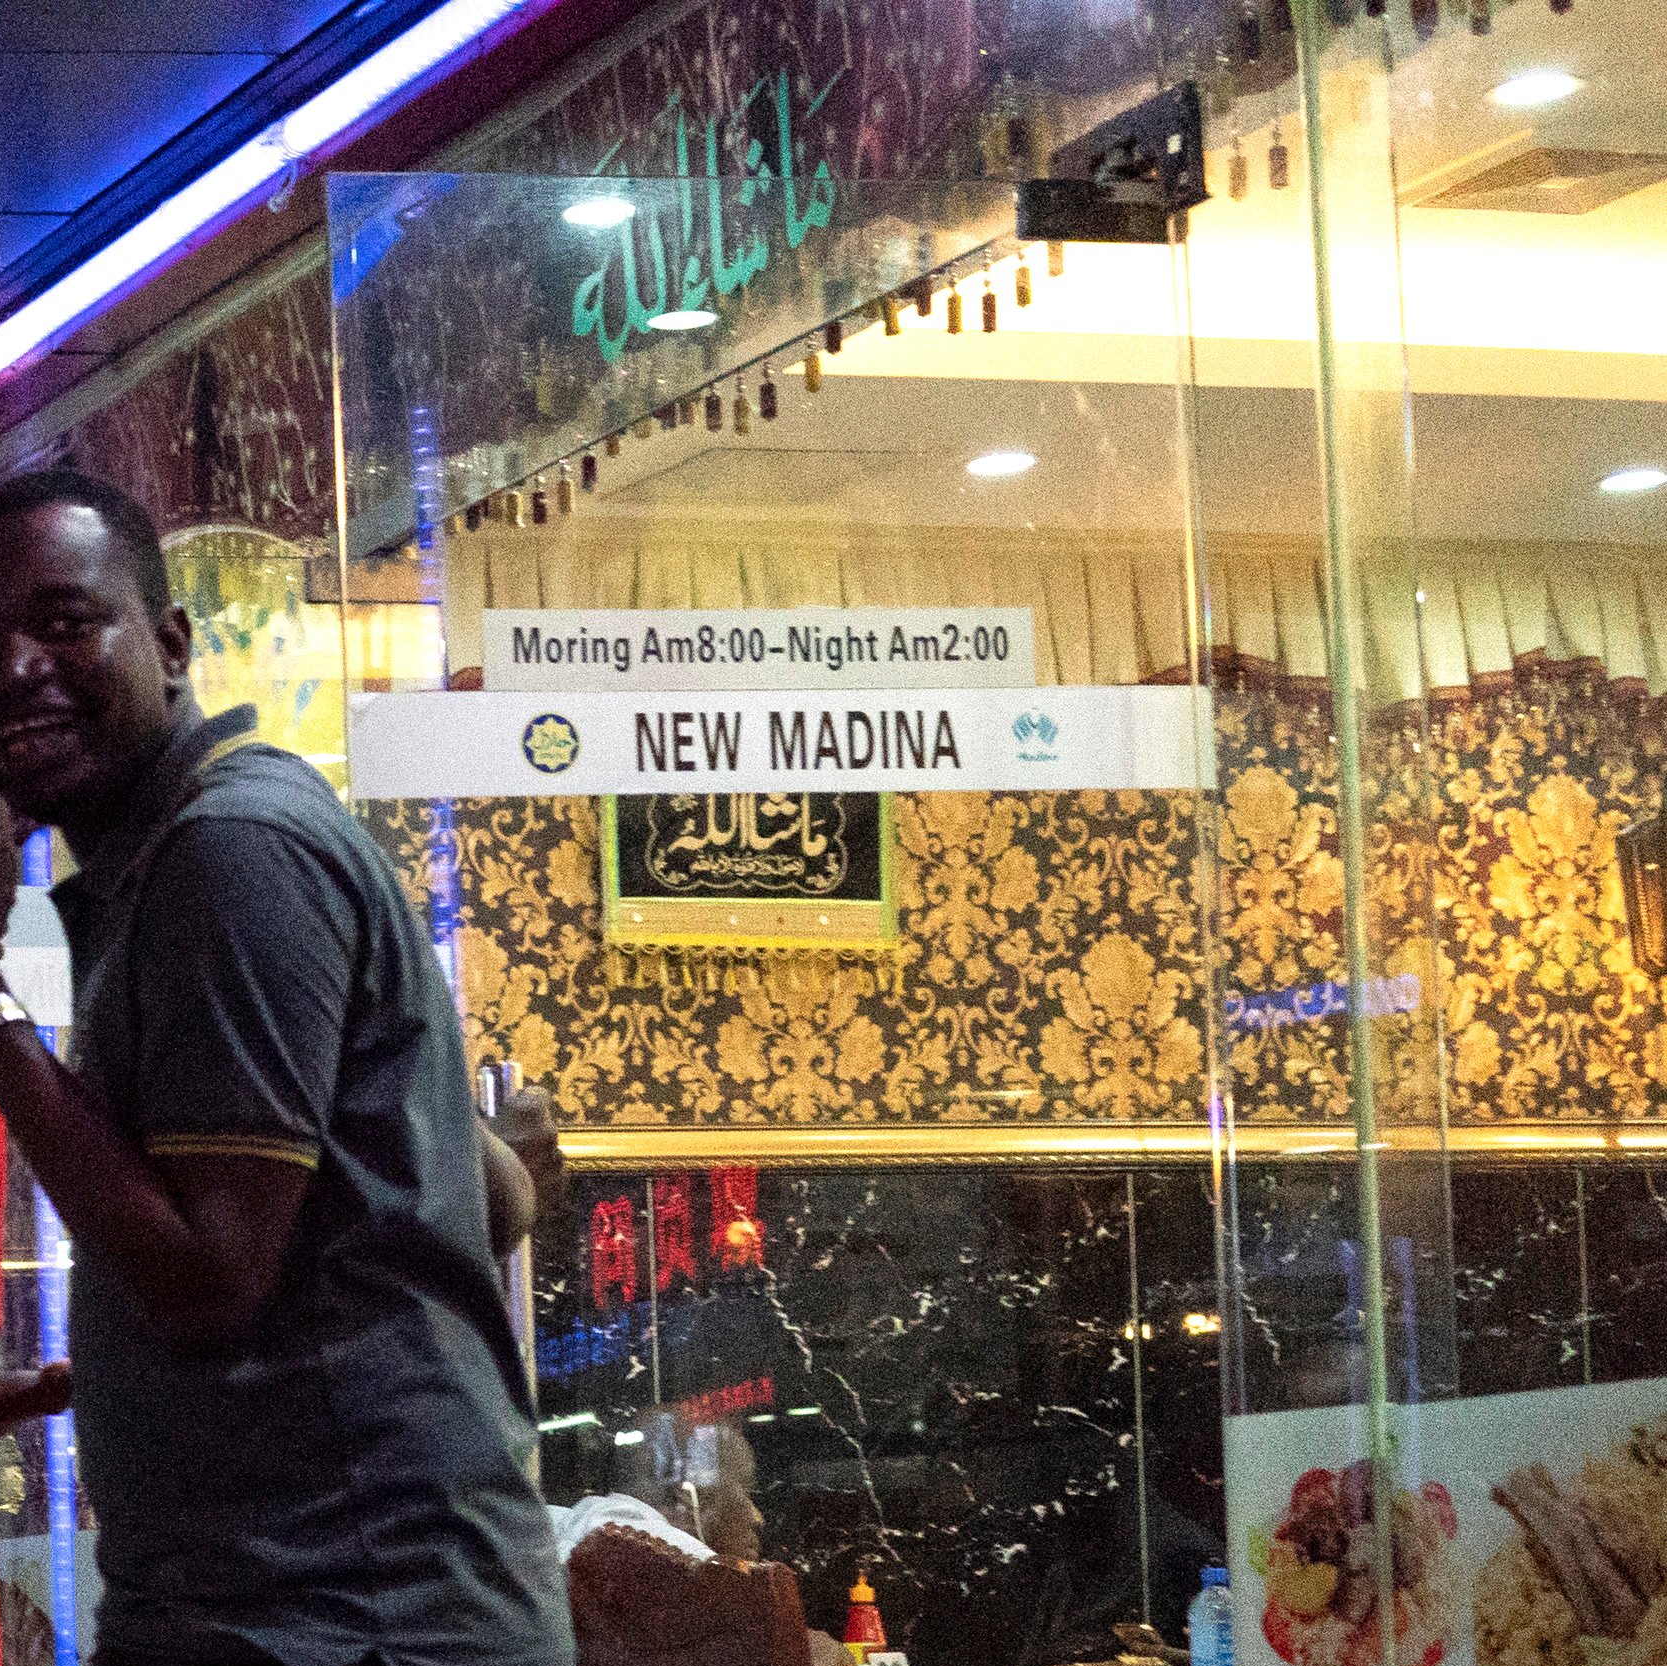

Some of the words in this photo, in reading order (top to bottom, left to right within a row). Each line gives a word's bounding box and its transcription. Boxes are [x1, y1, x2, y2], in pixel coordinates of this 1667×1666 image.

[512, 626, 630, 672] Moring
[888, 623, 1009, 662] Am2:00
[635, 711, 741, 772] NEW
[768, 709, 961, 771] MADINA
